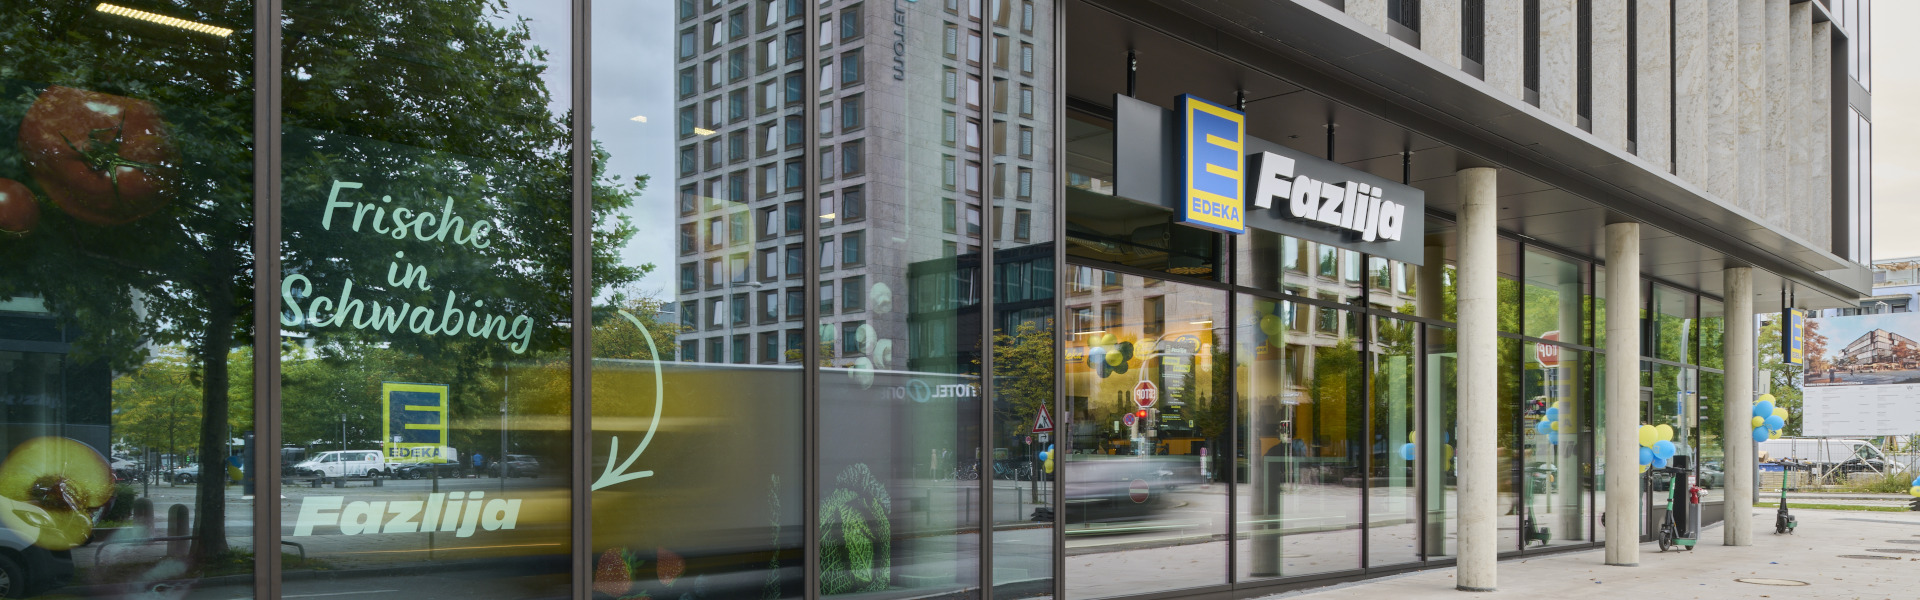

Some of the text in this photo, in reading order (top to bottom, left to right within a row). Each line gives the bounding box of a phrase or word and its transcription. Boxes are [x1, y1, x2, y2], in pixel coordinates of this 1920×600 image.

[322, 179, 491, 249] Frische
[1192, 197, 1239, 222] EDEKA
[1255, 151, 1405, 242] Fazlija
[387, 251, 431, 291] in
[280, 273, 535, 355] Schwabing
[389, 446, 443, 458] EDEKA
[292, 490, 522, 538] Fazlija
